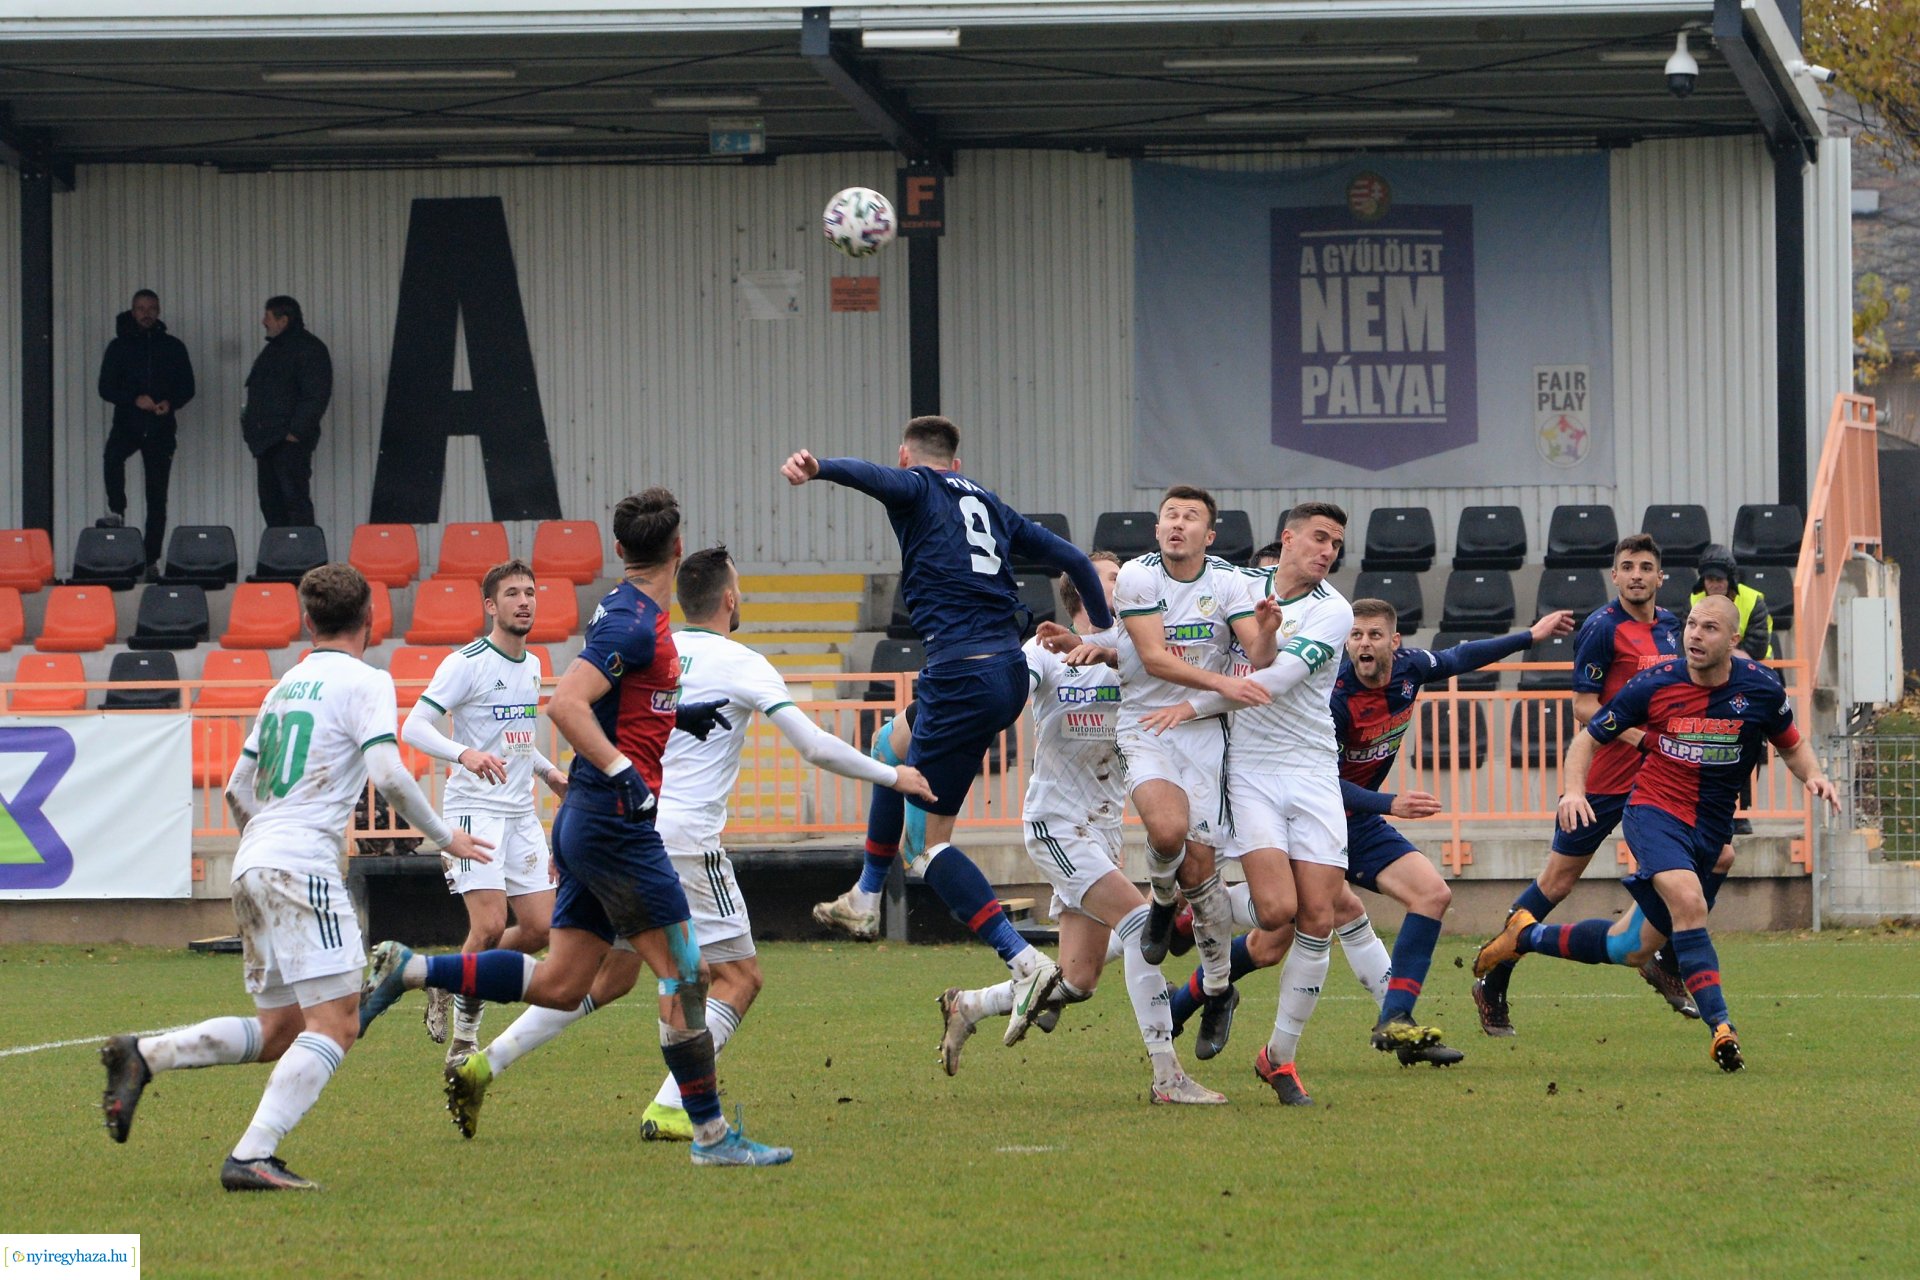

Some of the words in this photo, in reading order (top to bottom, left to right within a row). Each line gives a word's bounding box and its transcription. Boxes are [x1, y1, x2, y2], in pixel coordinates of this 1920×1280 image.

[907, 176, 936, 216] F
[1300, 246, 1318, 274] A
[1323, 238, 1443, 274] GYŰLÖLET
[1300, 276, 1446, 353] NEM
[369, 196, 563, 524] A
[1302, 355, 1447, 416] PÁLYA!
[1537, 371, 1587, 391] FAIR
[1537, 392, 1587, 411] PLAY
[958, 495, 1002, 575] 9
[1070, 724, 1116, 733] automotive
